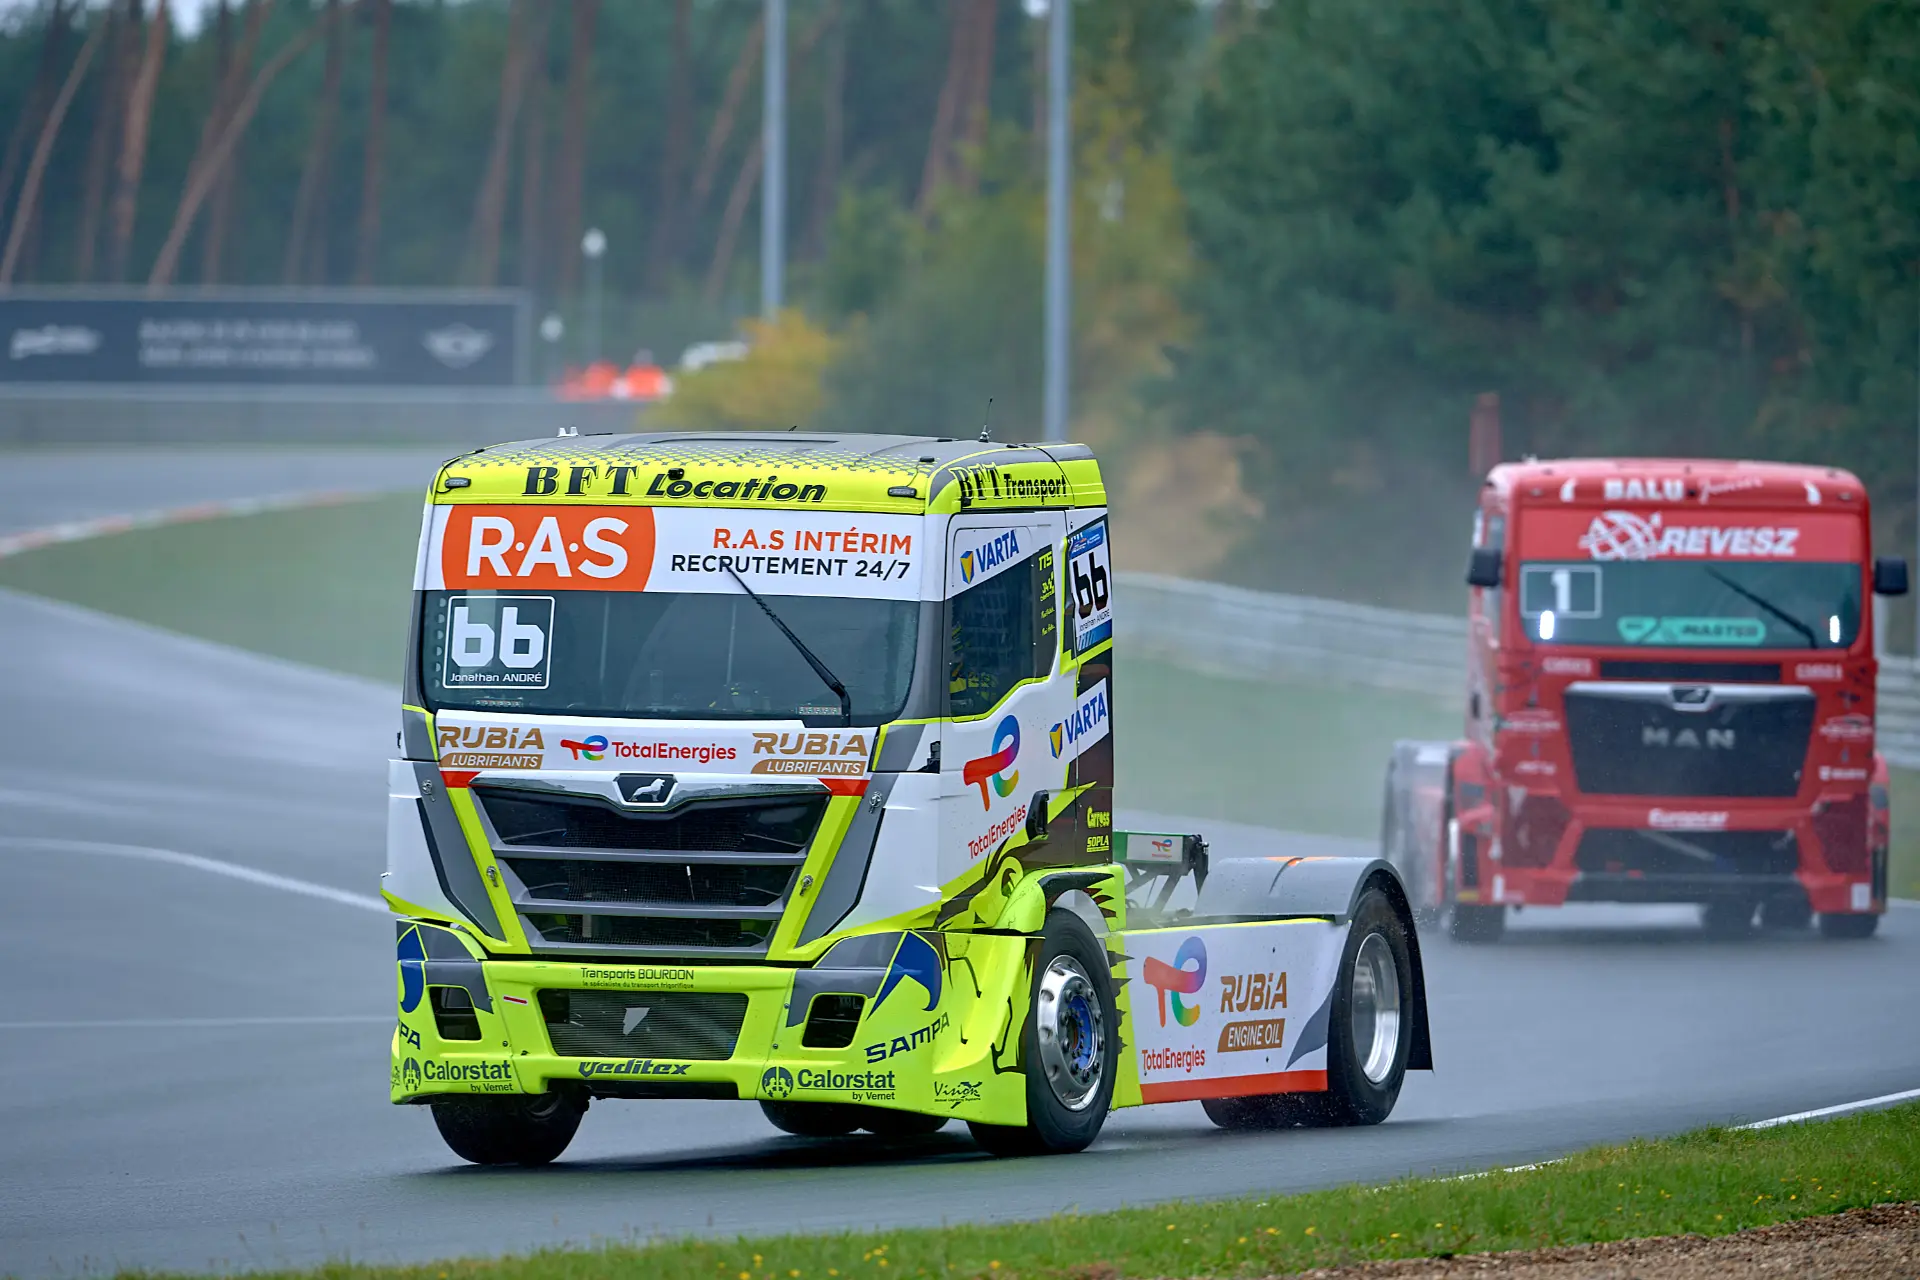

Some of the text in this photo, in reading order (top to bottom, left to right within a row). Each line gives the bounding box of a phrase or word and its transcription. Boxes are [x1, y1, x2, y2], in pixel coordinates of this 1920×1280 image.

[521, 464, 828, 502] BFT Location
[948, 461, 1068, 506] BFT Transport
[1603, 478, 1685, 501] BALU
[712, 526, 912, 556] R.A.S INTÉRIM
[976, 530, 1020, 573] VARTA
[1657, 526, 1799, 557] REVESZ
[671, 554, 911, 581] RECRUTEMENT 24/7
[1551, 569, 1571, 613] 1
[450, 671, 543, 683] Jonathan ANDRÉ
[1064, 690, 1108, 745] VARTA
[1641, 726, 1738, 750] MAN
[450, 753, 539, 768] LUBRIFIANTS
[611, 741, 737, 764] TotalEnergies
[766, 761, 861, 774] LUBRIFIANTS
[967, 803, 1027, 860] TotalEnergies
[1086, 834, 1110, 848] SOPLA
[580, 967, 695, 981] Transports BOURDON
[589, 980, 621, 988] spécialiste
[660, 981, 695, 990] frigorifique
[863, 1011, 951, 1065] SAMPA
[1227, 1023, 1281, 1048] ENGINE OIL
[423, 1059, 512, 1081] Calorstat
[1141, 1045, 1206, 1074] TotalEnergies
[470, 1082, 514, 1094] by Vernet
[797, 1068, 895, 1090] Calorstat
[933, 1080, 982, 1097] Vision
[852, 1091, 896, 1102] by Vernet
